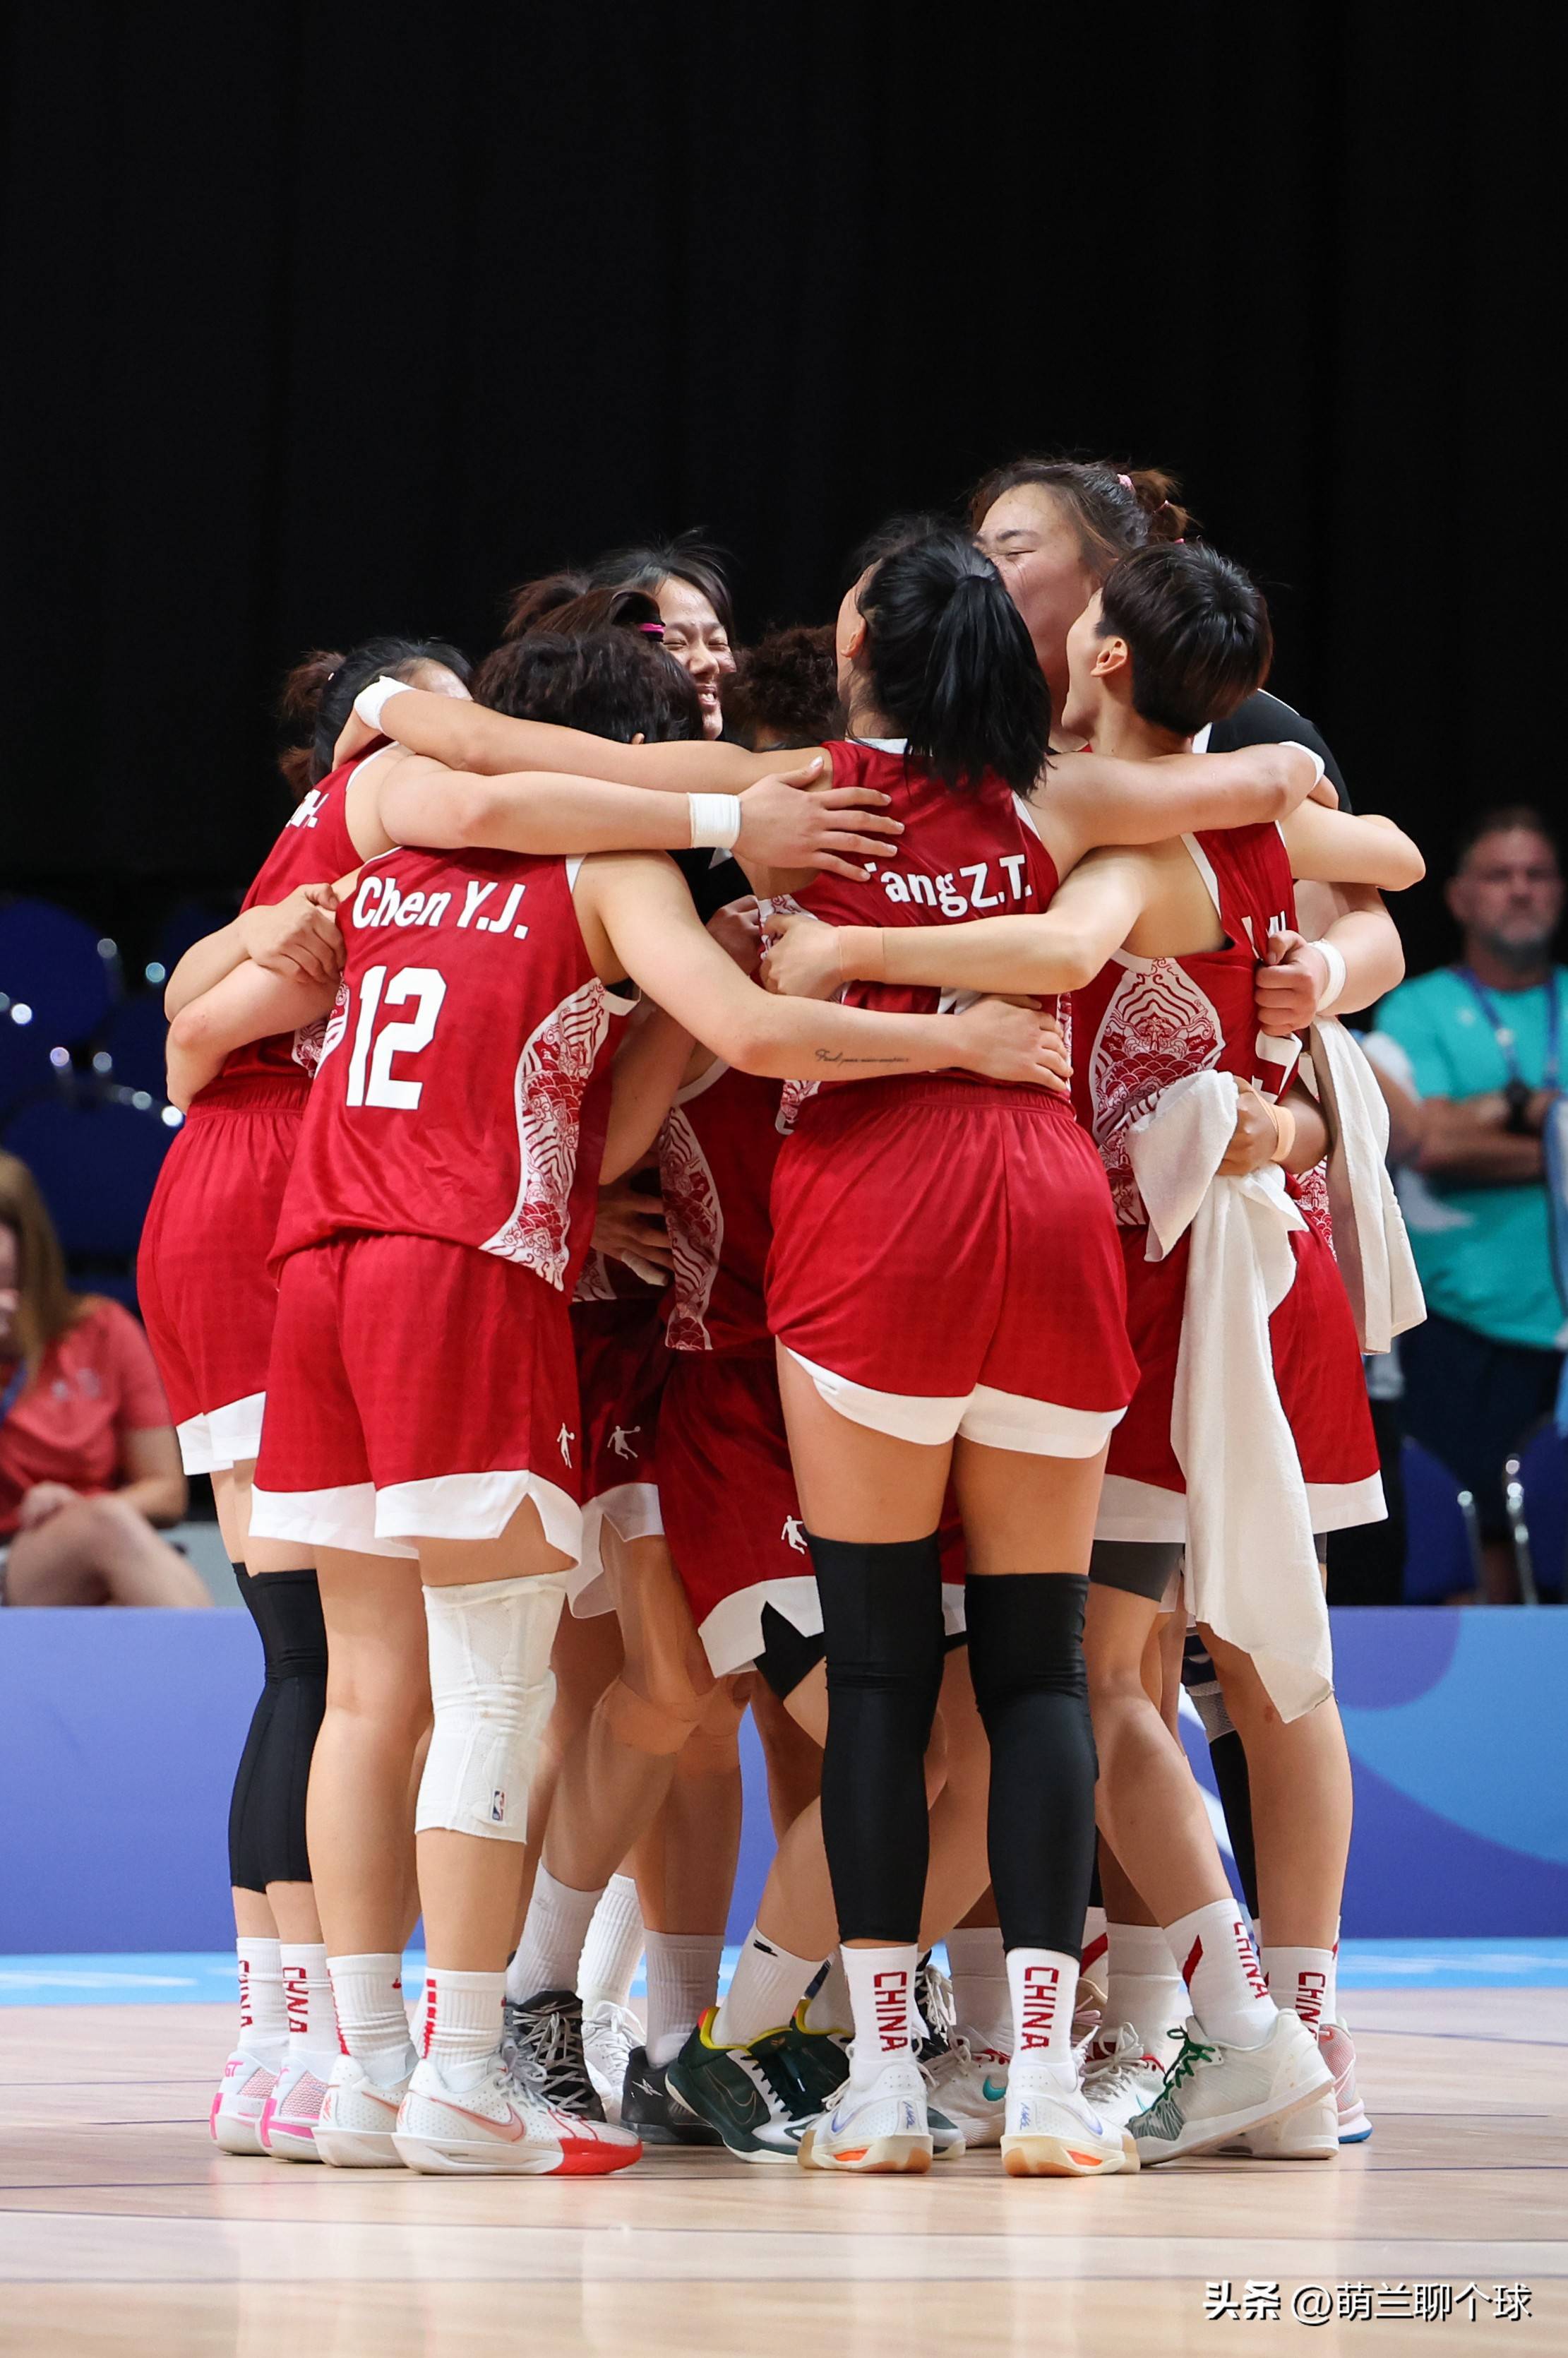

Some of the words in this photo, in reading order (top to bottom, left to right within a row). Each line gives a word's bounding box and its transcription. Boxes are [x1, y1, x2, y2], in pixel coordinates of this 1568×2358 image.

[352, 876, 452, 929] Chen
[456, 880, 529, 940] Y.J.
[346, 965, 446, 1109] 12
[873, 1971, 909, 2052] CHINA
[1021, 1966, 1060, 2051] CHINA
